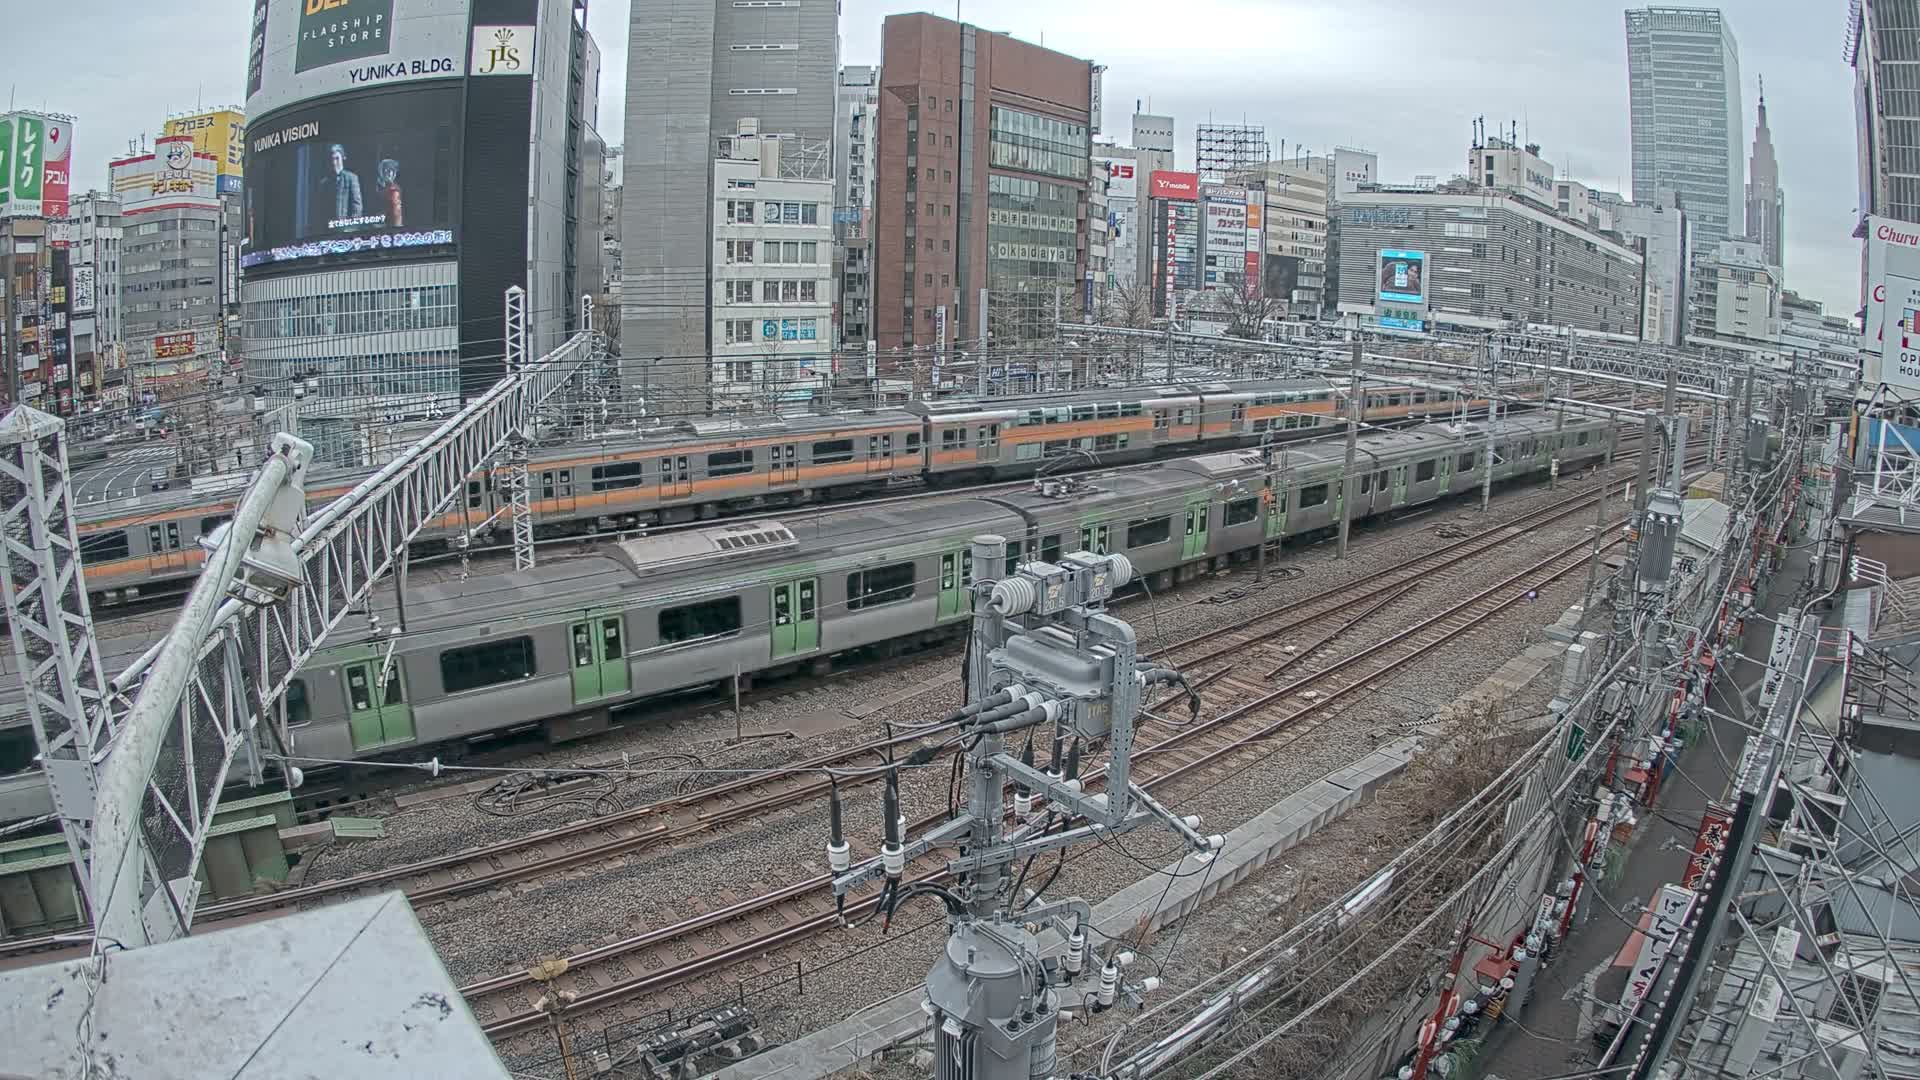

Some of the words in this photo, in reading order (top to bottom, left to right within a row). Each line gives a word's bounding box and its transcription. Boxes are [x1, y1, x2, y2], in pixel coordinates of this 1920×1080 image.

[303, 14, 383, 41] FLAGSHIP
[328, 28, 382, 48] STORE
[349, 62, 408, 83] YUNIKA
[411, 57, 456, 75] BLDG.
[254, 132, 281, 153] YUNIKA
[282, 121, 319, 143] VISION
[20, 121, 37, 188] レイク
[45, 169, 68, 185] アコム
[1000, 243, 1065, 261] okadaya
